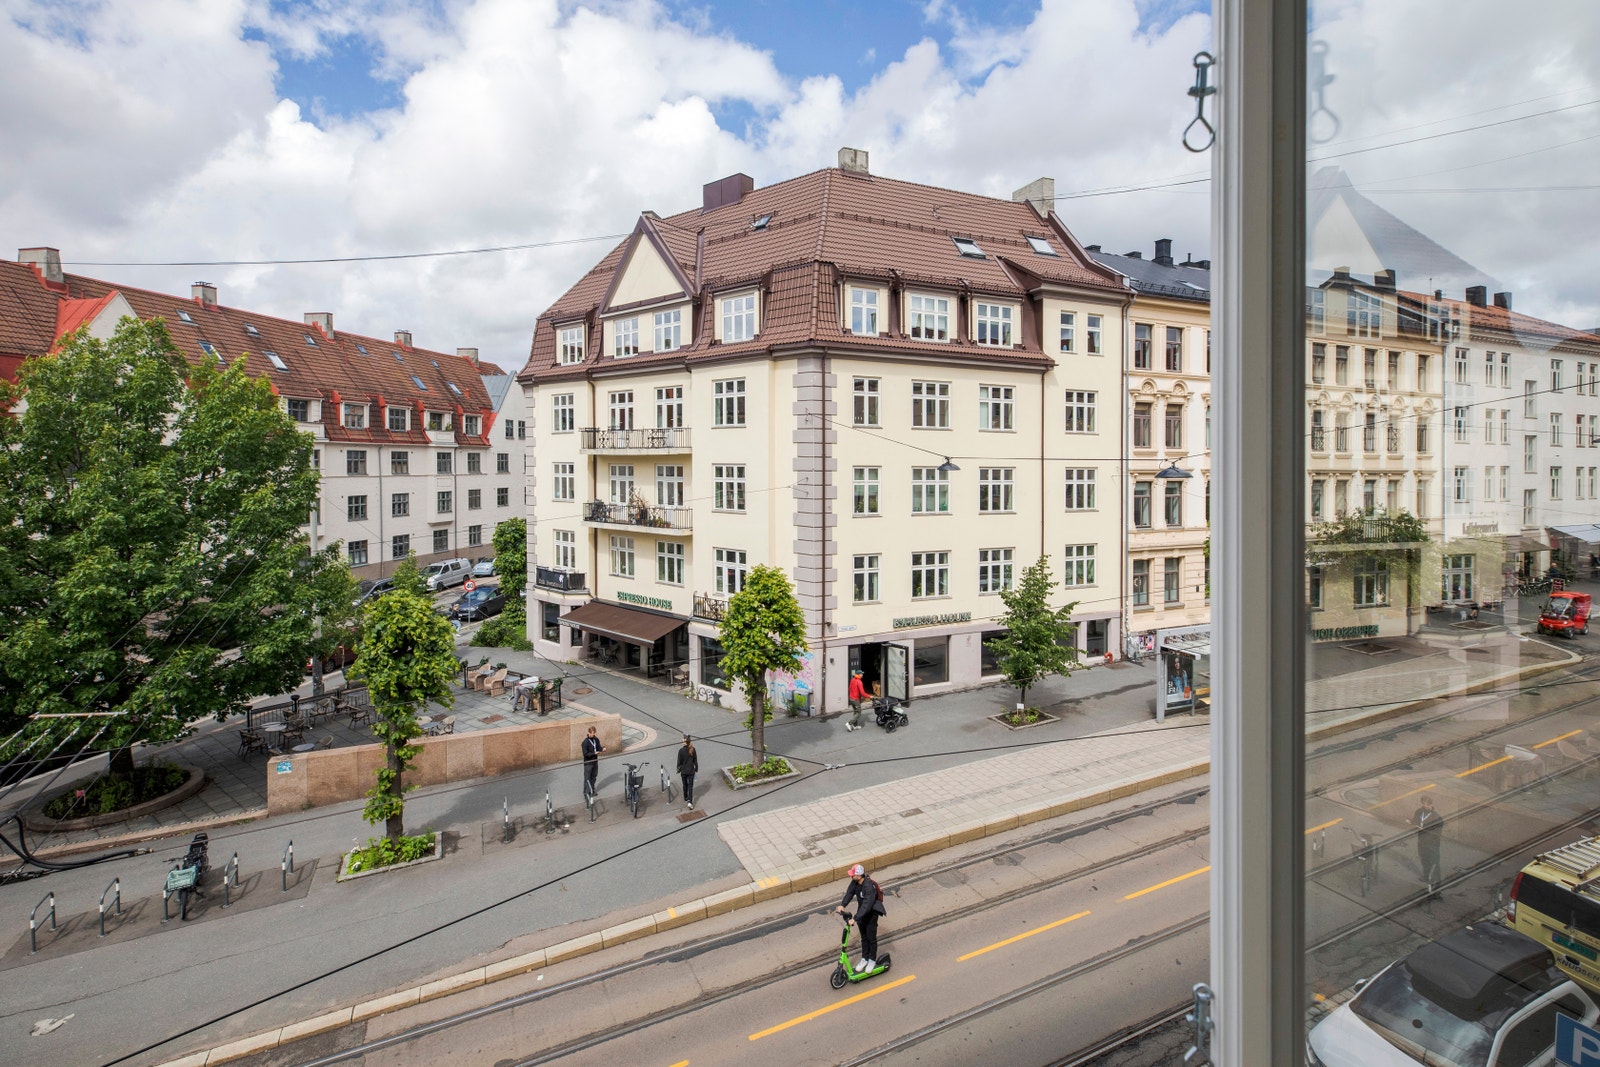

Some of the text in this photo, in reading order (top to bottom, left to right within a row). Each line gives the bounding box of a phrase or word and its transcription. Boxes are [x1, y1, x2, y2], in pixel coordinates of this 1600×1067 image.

[617, 591, 672, 610] ESPRESSO HOUSE
[893, 612, 971, 628] ESPRESSO HOUSE
[1572, 1027, 1600, 1065] P
